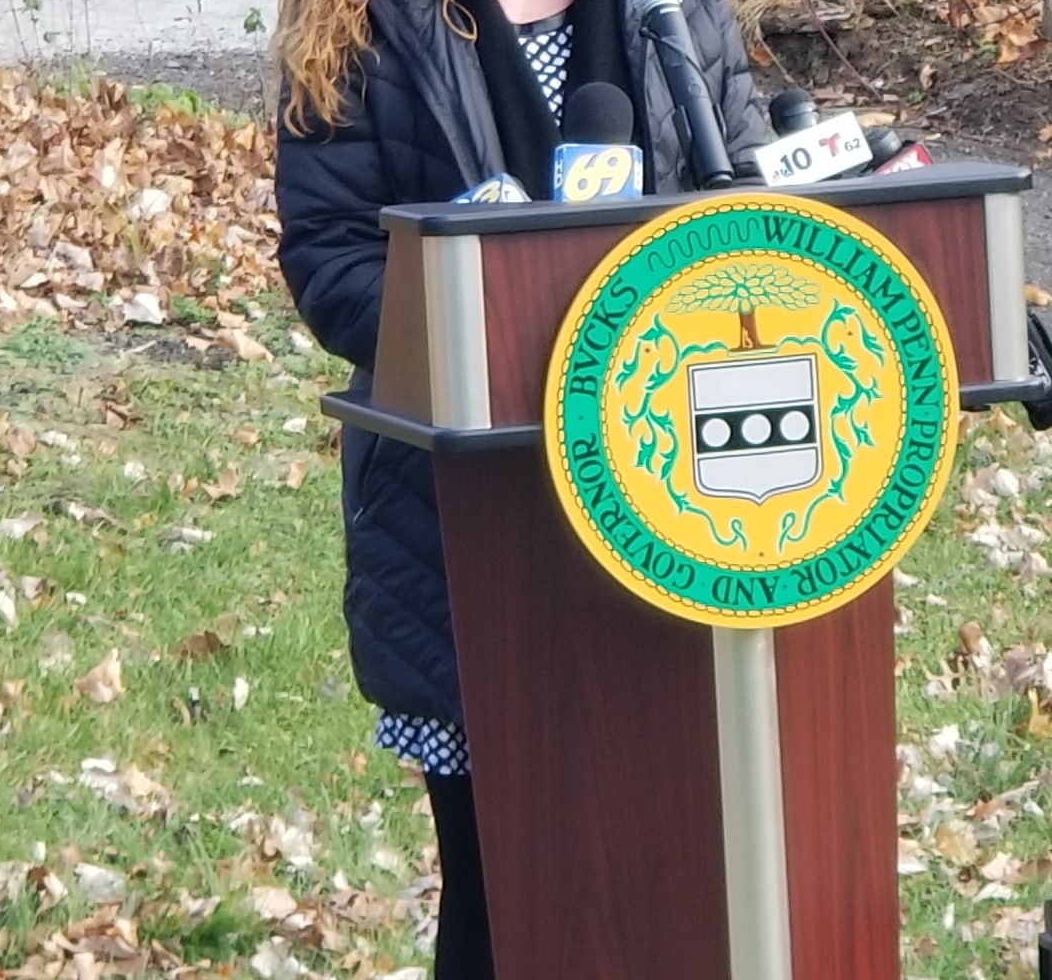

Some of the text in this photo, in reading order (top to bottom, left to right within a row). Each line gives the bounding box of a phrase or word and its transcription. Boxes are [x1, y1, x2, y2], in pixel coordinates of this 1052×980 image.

[563, 147, 633, 202] 69
[780, 147, 813, 177] 10
[844, 138, 862, 152] 62
[762, 215, 906, 314] WILLIAM
[893, 309, 940, 407] PENN
[572, 433, 696, 590] GOVERNOR
[792, 418, 938, 596] PROPRIATOR
[711, 575, 780, 606] AND
